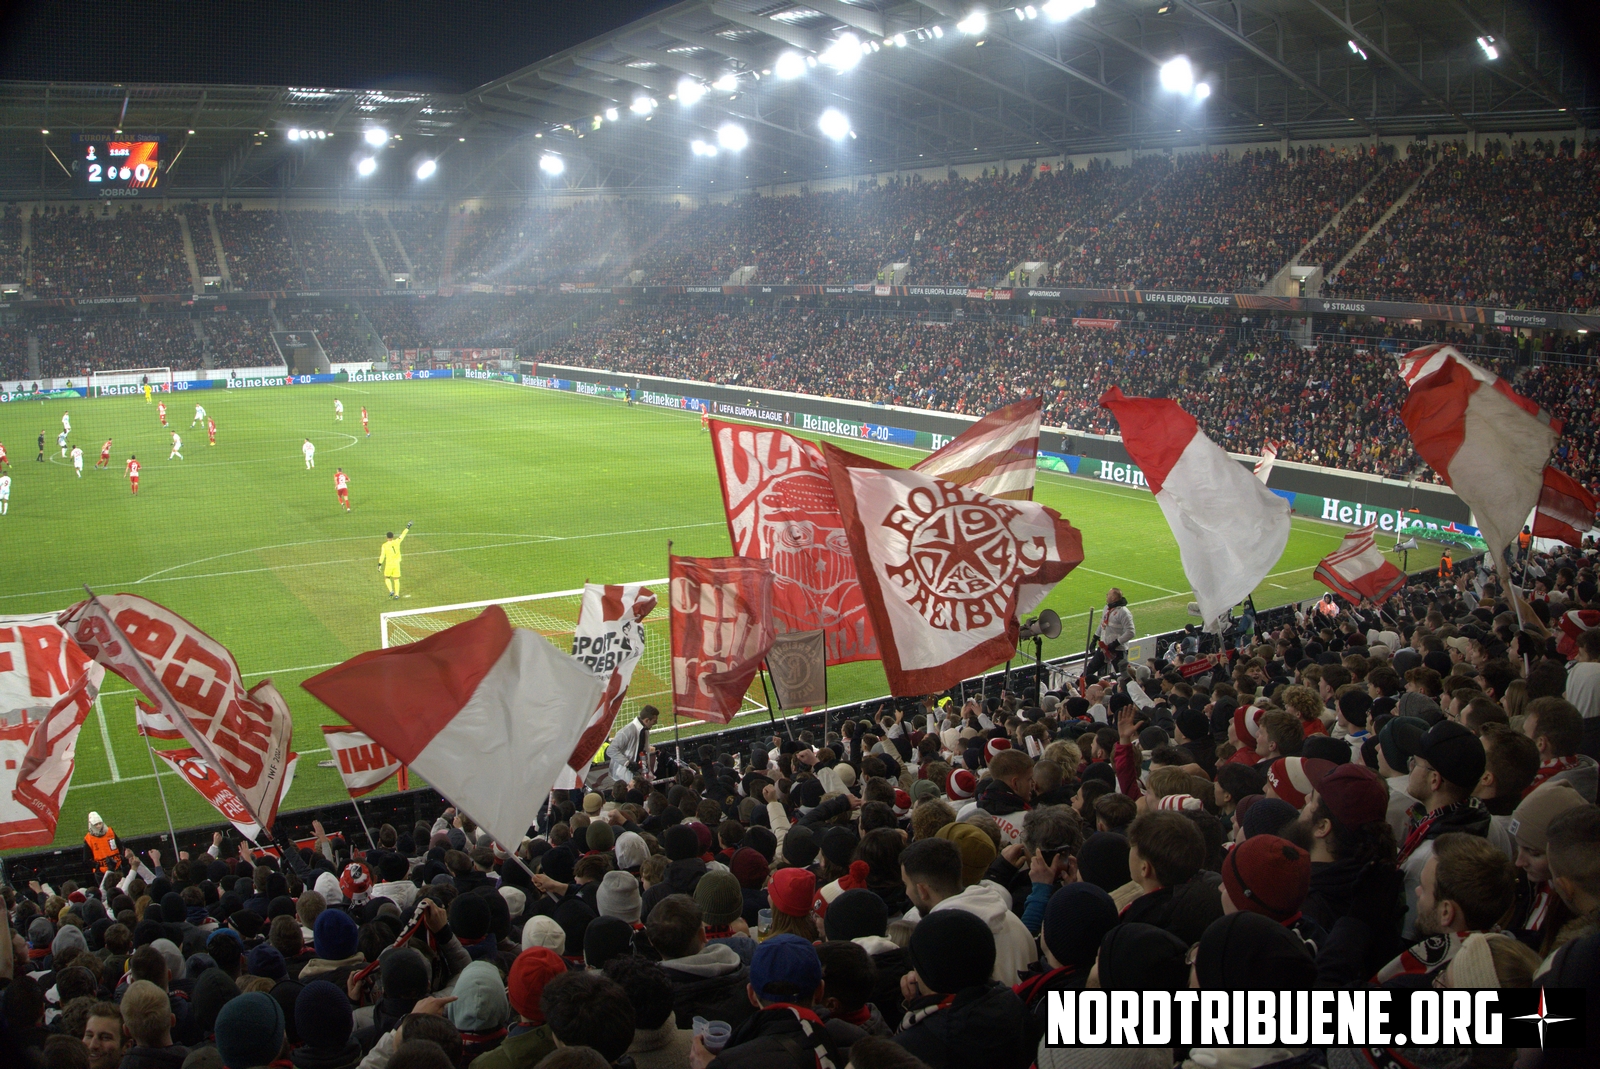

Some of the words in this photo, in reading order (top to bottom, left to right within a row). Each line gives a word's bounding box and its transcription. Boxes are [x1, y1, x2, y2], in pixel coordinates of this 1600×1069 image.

[88, 164, 102, 182] 2
[135, 163, 149, 182] 0
[99, 188, 138, 196] JOBRAD
[910, 287, 924, 295] UEFA
[925, 288, 944, 296] EUROPA
[946, 288, 967, 296] LEAGUE
[1145, 293, 1166, 302] UEFA
[1167, 294, 1197, 304] EUROPA
[1198, 296, 1230, 305] LEAGUE
[1331, 302, 1365, 312] STRAUSS
[226, 375, 284, 388] Heineken
[348, 369, 406, 382] Heineken
[522, 374, 547, 388] Heineken
[101, 383, 160, 396] Heinekn
[643, 391, 679, 408] Heineken
[719, 404, 734, 414] UEFA
[734, 406, 757, 417] EUROPA
[758, 409, 783, 421] LEAGUE
[803, 413, 858, 437] Heineken
[267, 764, 278, 780] IWF
